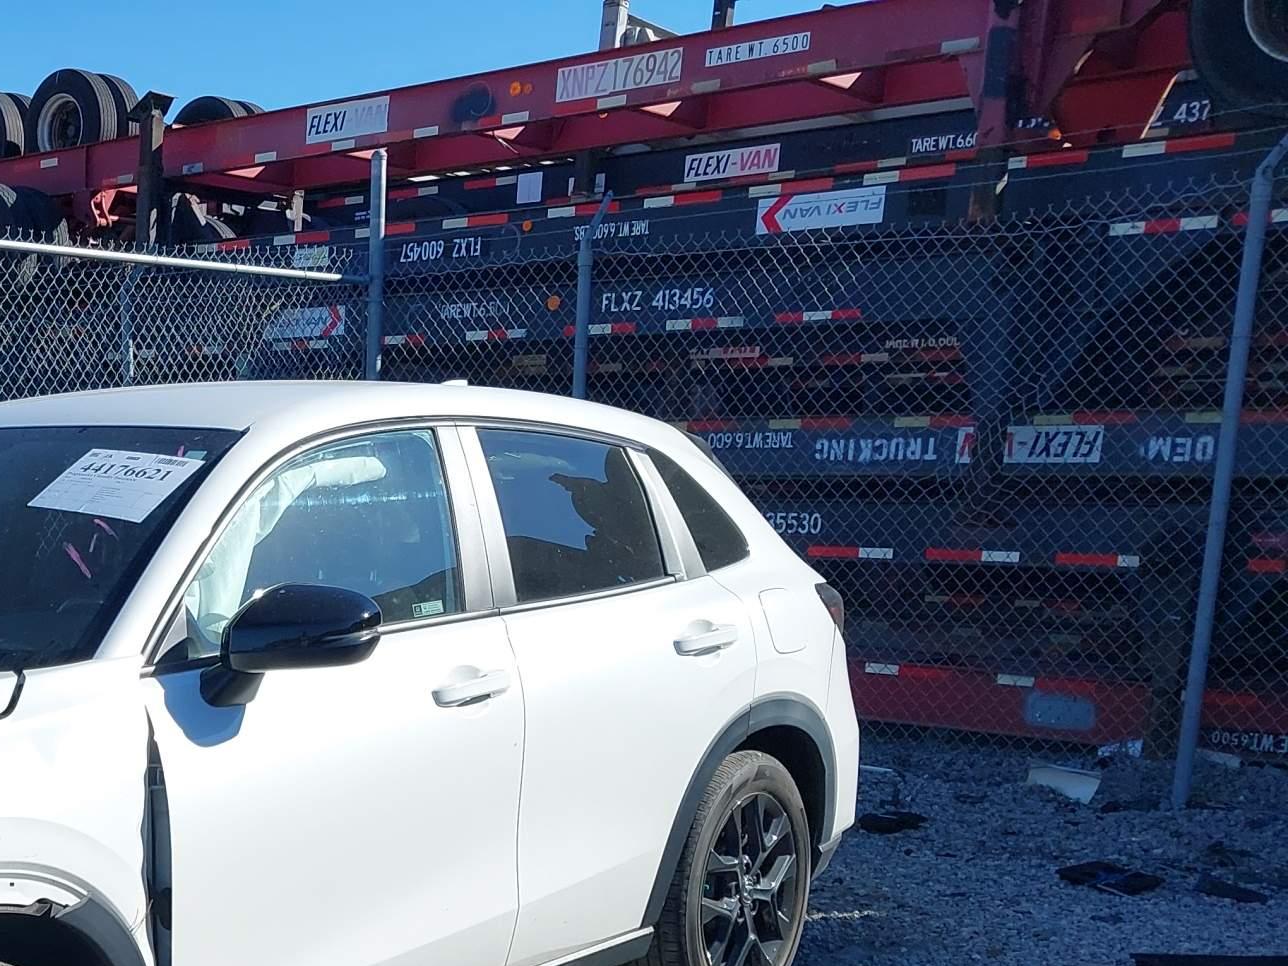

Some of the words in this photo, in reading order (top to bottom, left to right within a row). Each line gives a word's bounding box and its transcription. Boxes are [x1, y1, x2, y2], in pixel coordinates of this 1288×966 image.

[707, 44, 742, 65] TARE
[772, 33, 809, 54] 6500
[686, 147, 778, 178] FLEXI-VAN
[399, 239, 445, 263] 600457
[452, 236, 482, 258] FLXZ
[601, 290, 643, 313] FLXZ
[651, 287, 714, 311] 413456
[814, 436, 937, 462] TRUCKING
[79, 461, 173, 481] 44176621
